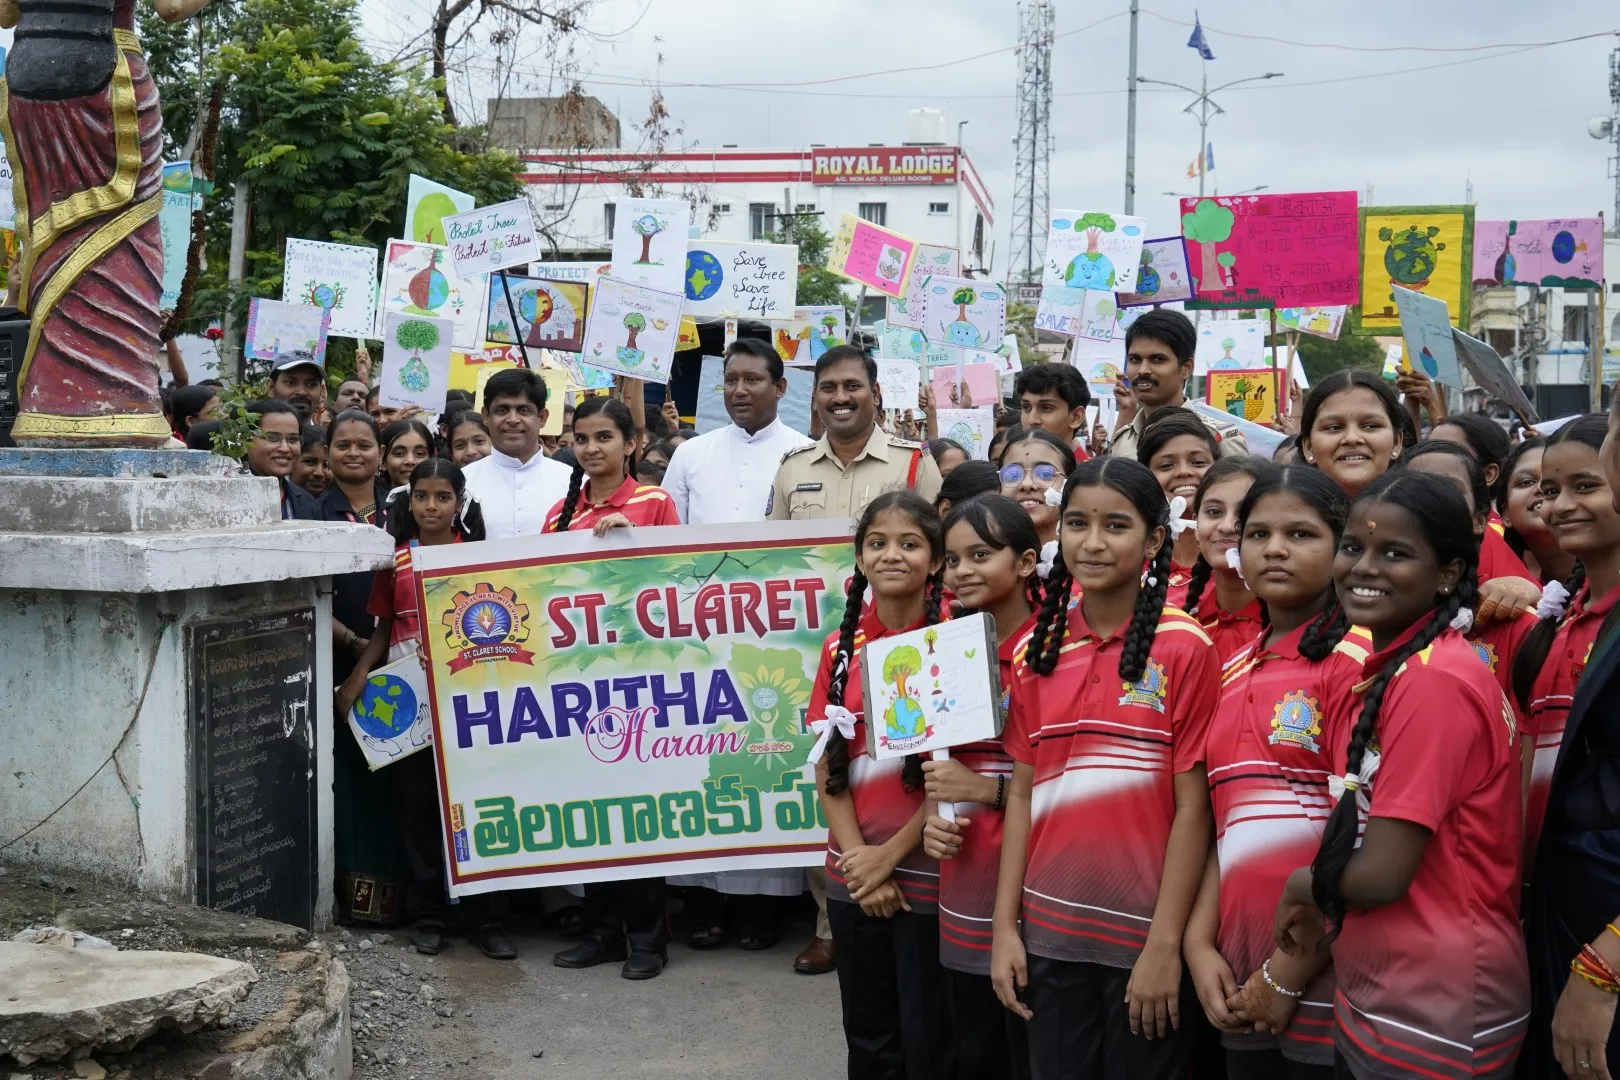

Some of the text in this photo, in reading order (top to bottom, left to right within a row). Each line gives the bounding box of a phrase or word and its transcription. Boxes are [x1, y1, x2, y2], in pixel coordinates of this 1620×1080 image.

[815, 154, 955, 175] ROYAL LODGE
[733, 251, 766, 271] Save
[537, 266, 589, 278] PROTECT
[753, 266, 785, 280] Tree
[732, 277, 769, 298] Save
[748, 297, 775, 316] Life
[1035, 312, 1070, 332] SAVE
[453, 601, 470, 640] KNOWLEDGE
[497, 595, 513, 609] WITH
[511, 608, 520, 633] VIRTUE
[550, 577, 826, 649] ST. CLARET
[472, 647, 494, 657] CLARET
[494, 646, 518, 655] SCHOOL
[451, 668, 749, 750] HARITHA
[585, 705, 747, 765] Haram
[473, 773, 763, 858] తెలంగాణకు
